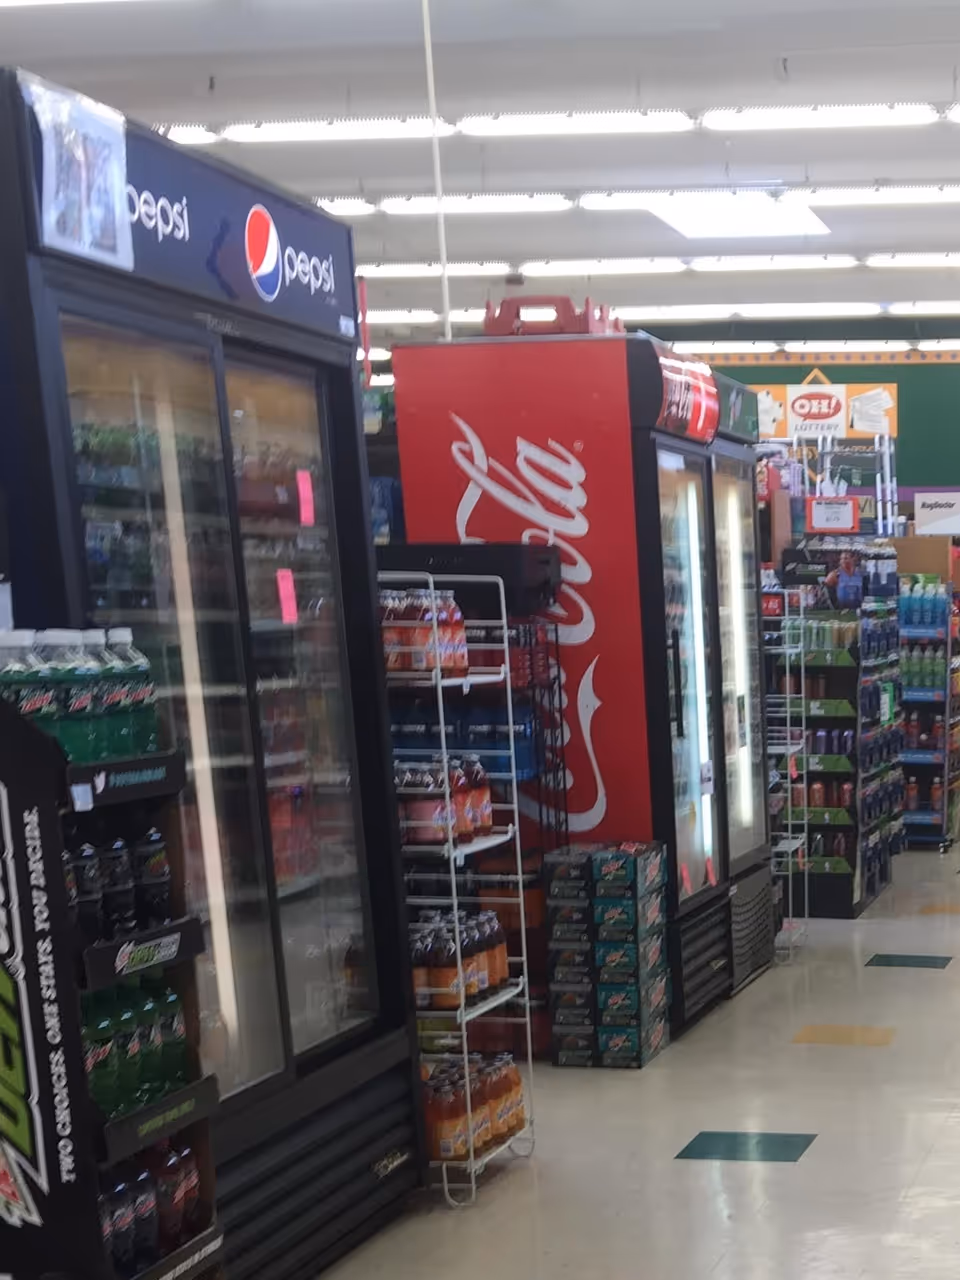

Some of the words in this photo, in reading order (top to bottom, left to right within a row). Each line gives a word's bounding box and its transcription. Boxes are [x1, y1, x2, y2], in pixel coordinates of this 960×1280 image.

[284, 246, 335, 294] pepsi
[793, 397, 838, 415] OH!
[56, 1139, 76, 1183] TWO
